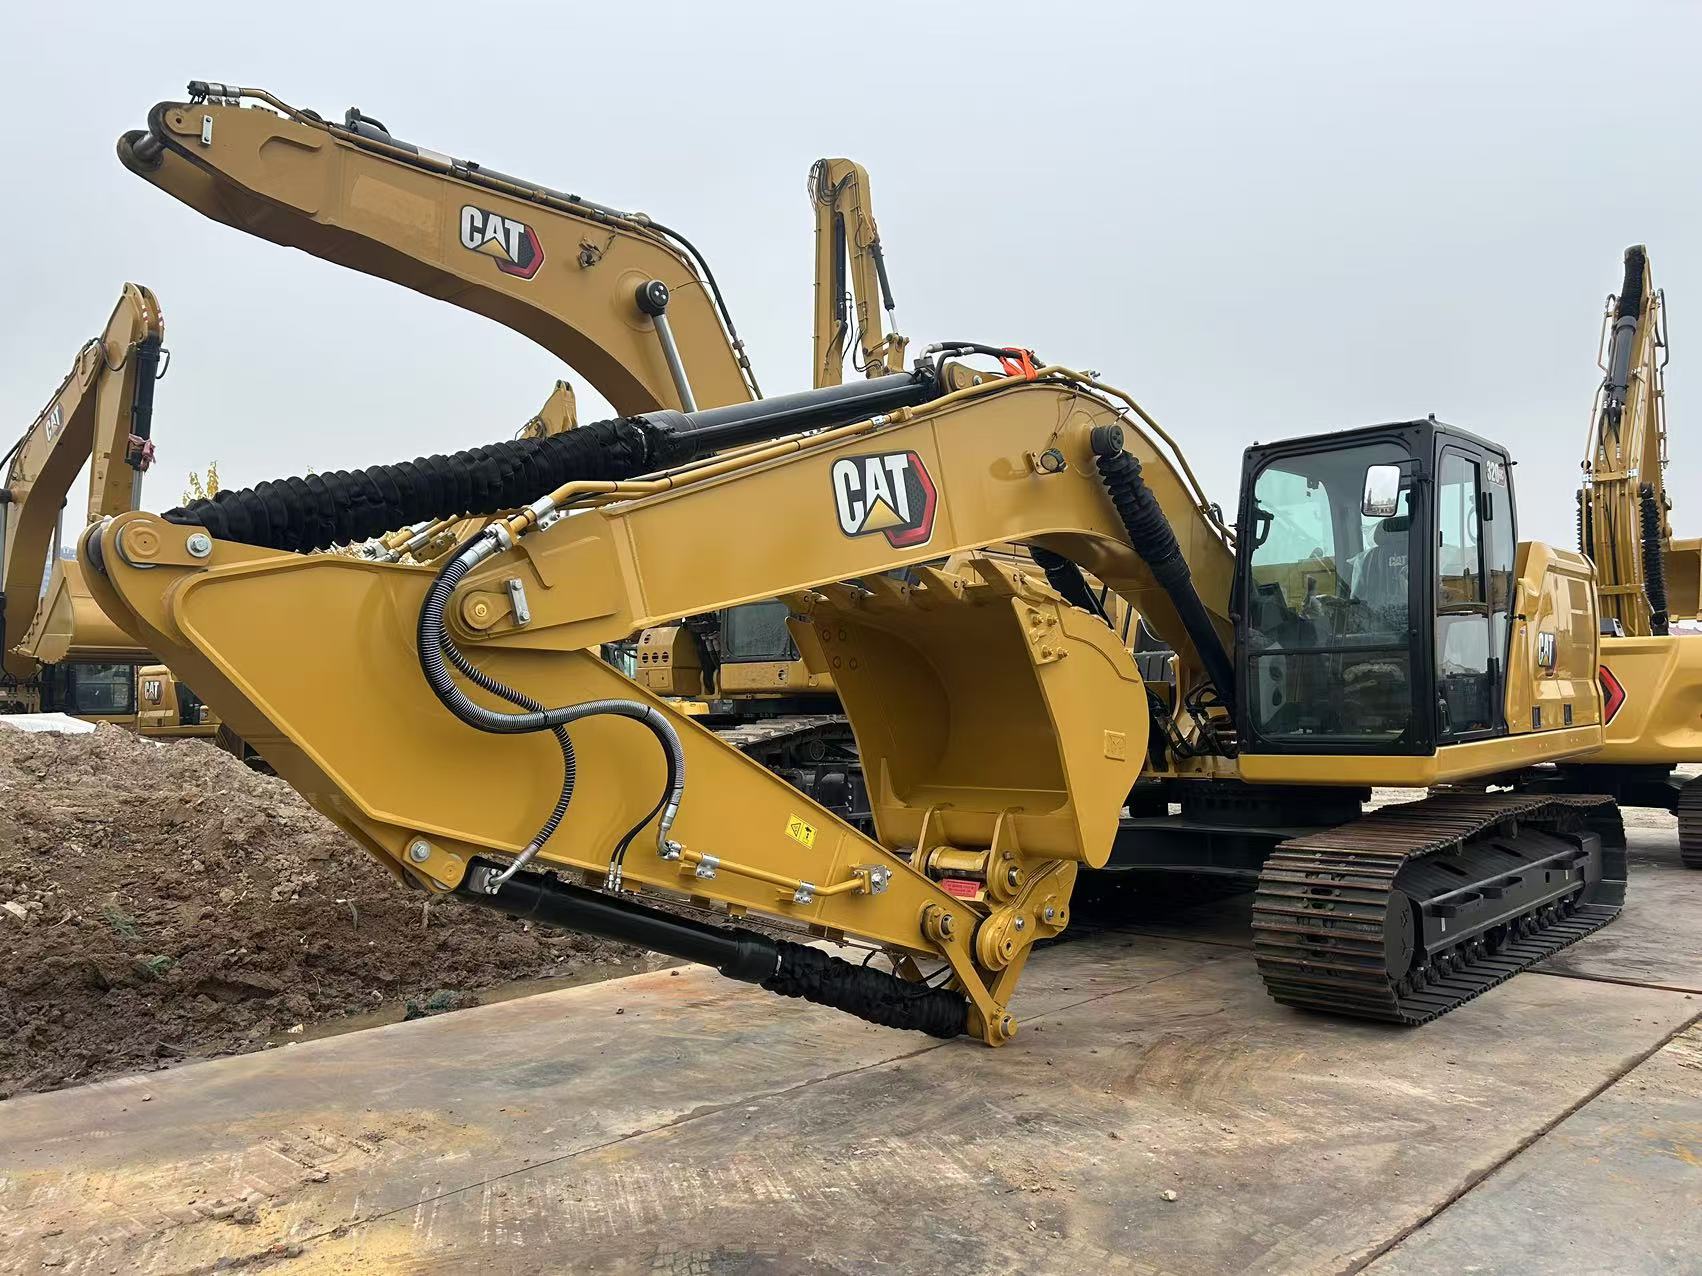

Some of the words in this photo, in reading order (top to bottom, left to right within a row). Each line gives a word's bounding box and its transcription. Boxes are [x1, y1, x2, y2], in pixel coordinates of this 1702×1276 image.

[461, 206, 525, 263] CAT
[46, 404, 60, 441] CAT
[1487, 460, 1500, 483] 320
[833, 454, 911, 534] CAT
[1538, 632, 1554, 666] CAT
[144, 681, 160, 700] CAT
